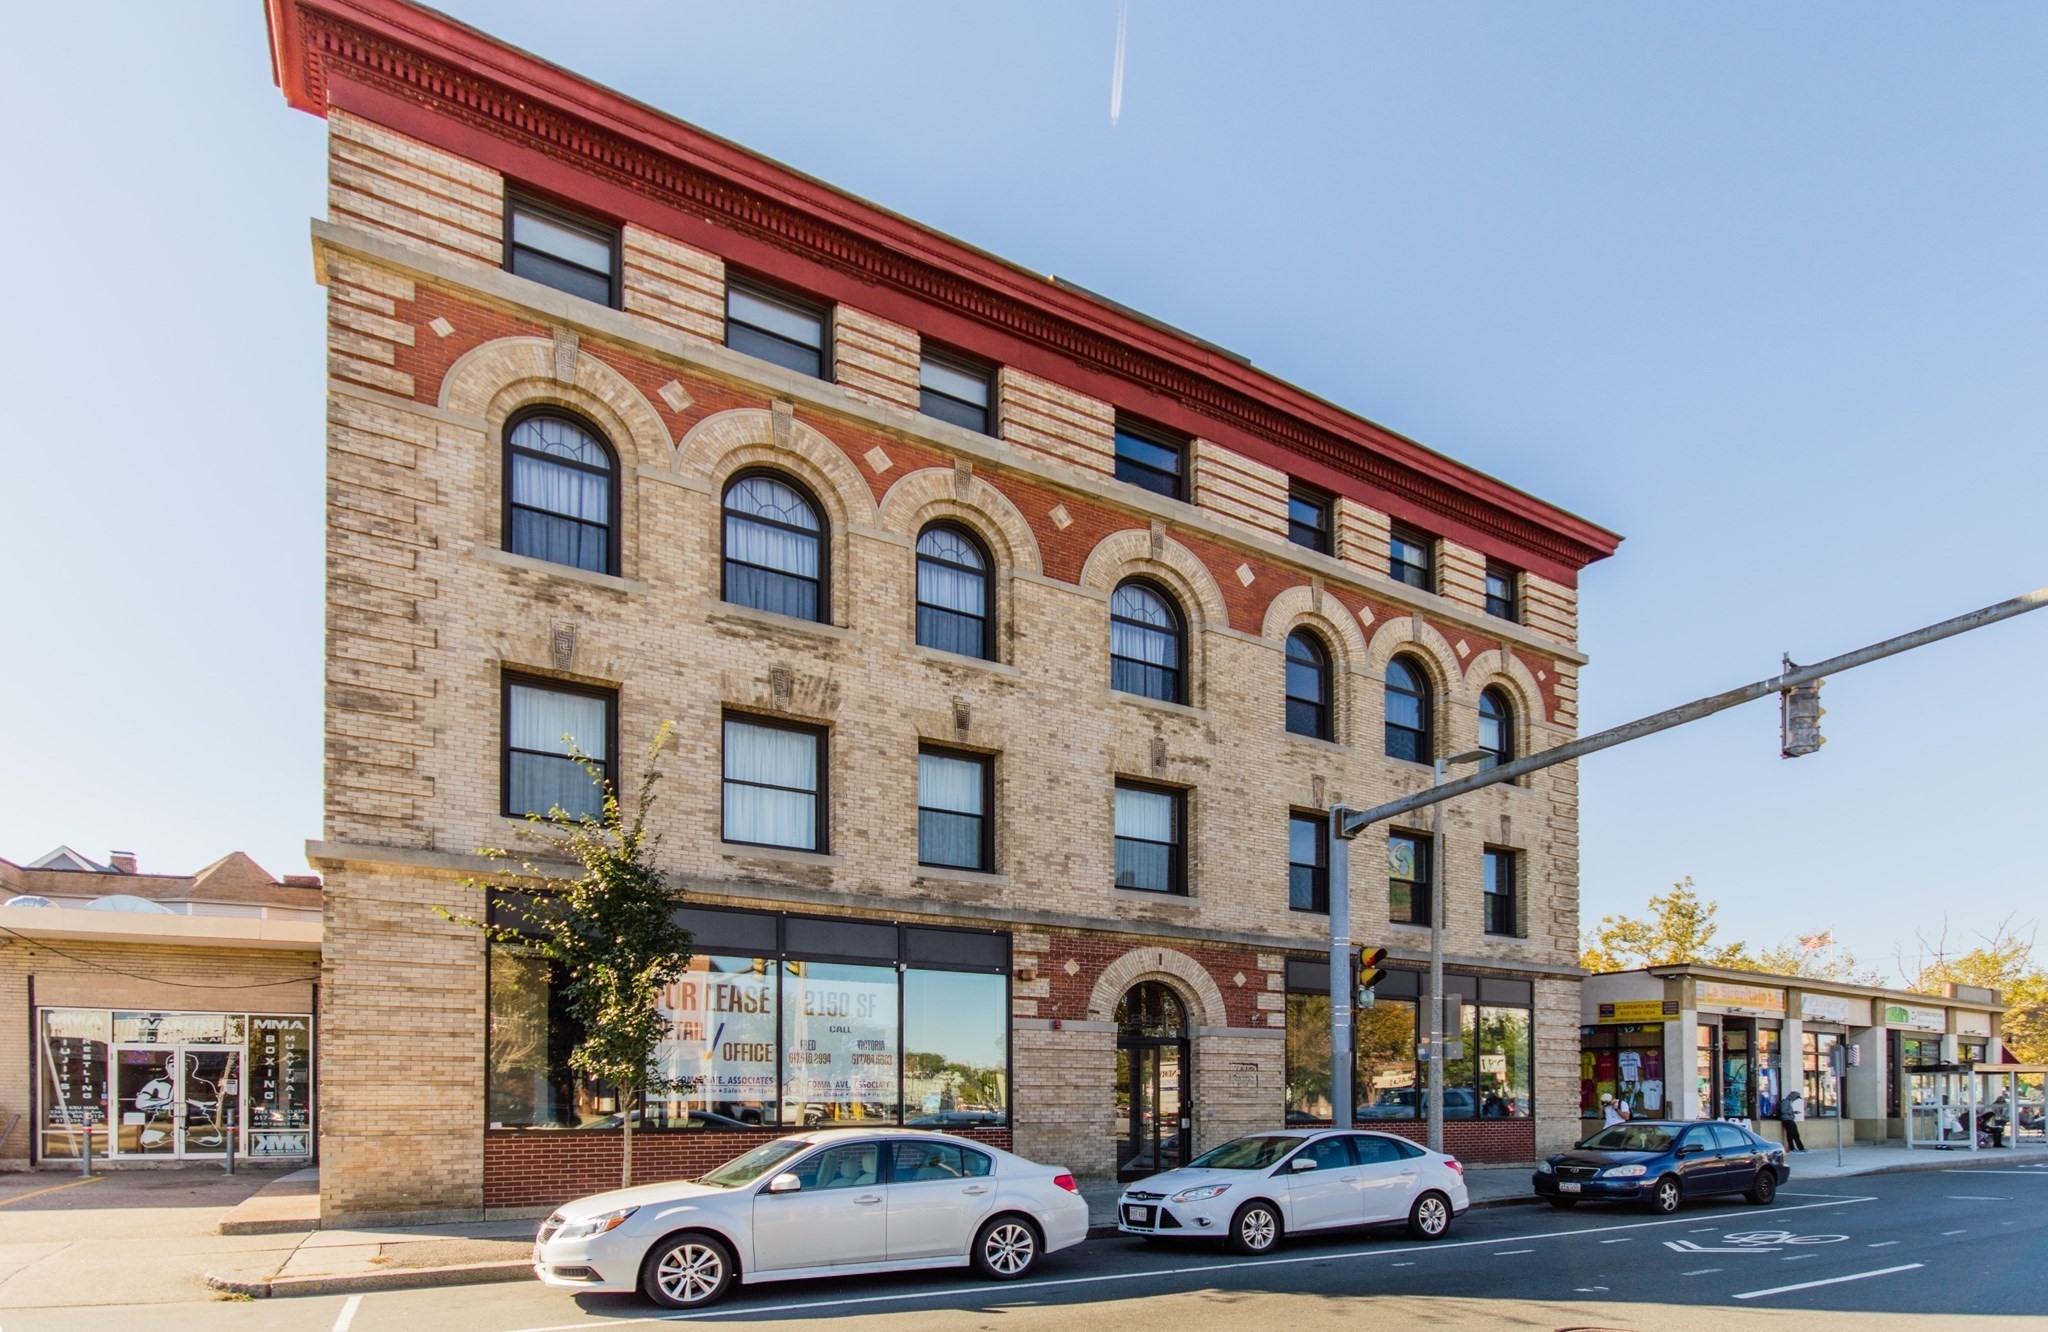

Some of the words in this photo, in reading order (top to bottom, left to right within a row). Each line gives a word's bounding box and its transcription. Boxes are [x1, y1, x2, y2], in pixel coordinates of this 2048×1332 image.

[705, 984, 771, 1014] LEASE
[804, 990, 850, 1017] 2150
[856, 993, 878, 1018] SF
[254, 1019, 306, 1030] MMA
[654, 1020, 707, 1041] ETAIL
[829, 1025, 852, 1034] CALL
[722, 1042, 774, 1062] OFFICE
[856, 1039, 885, 1051] VICTORIA
[264, 1035, 275, 1099] BOXING
[727, 1076, 774, 1085] ASSOCIATES
[835, 1080, 851, 1089] AVE.
[855, 1081, 895, 1089] SSOCIATES
[255, 1135, 305, 1150] KMK
